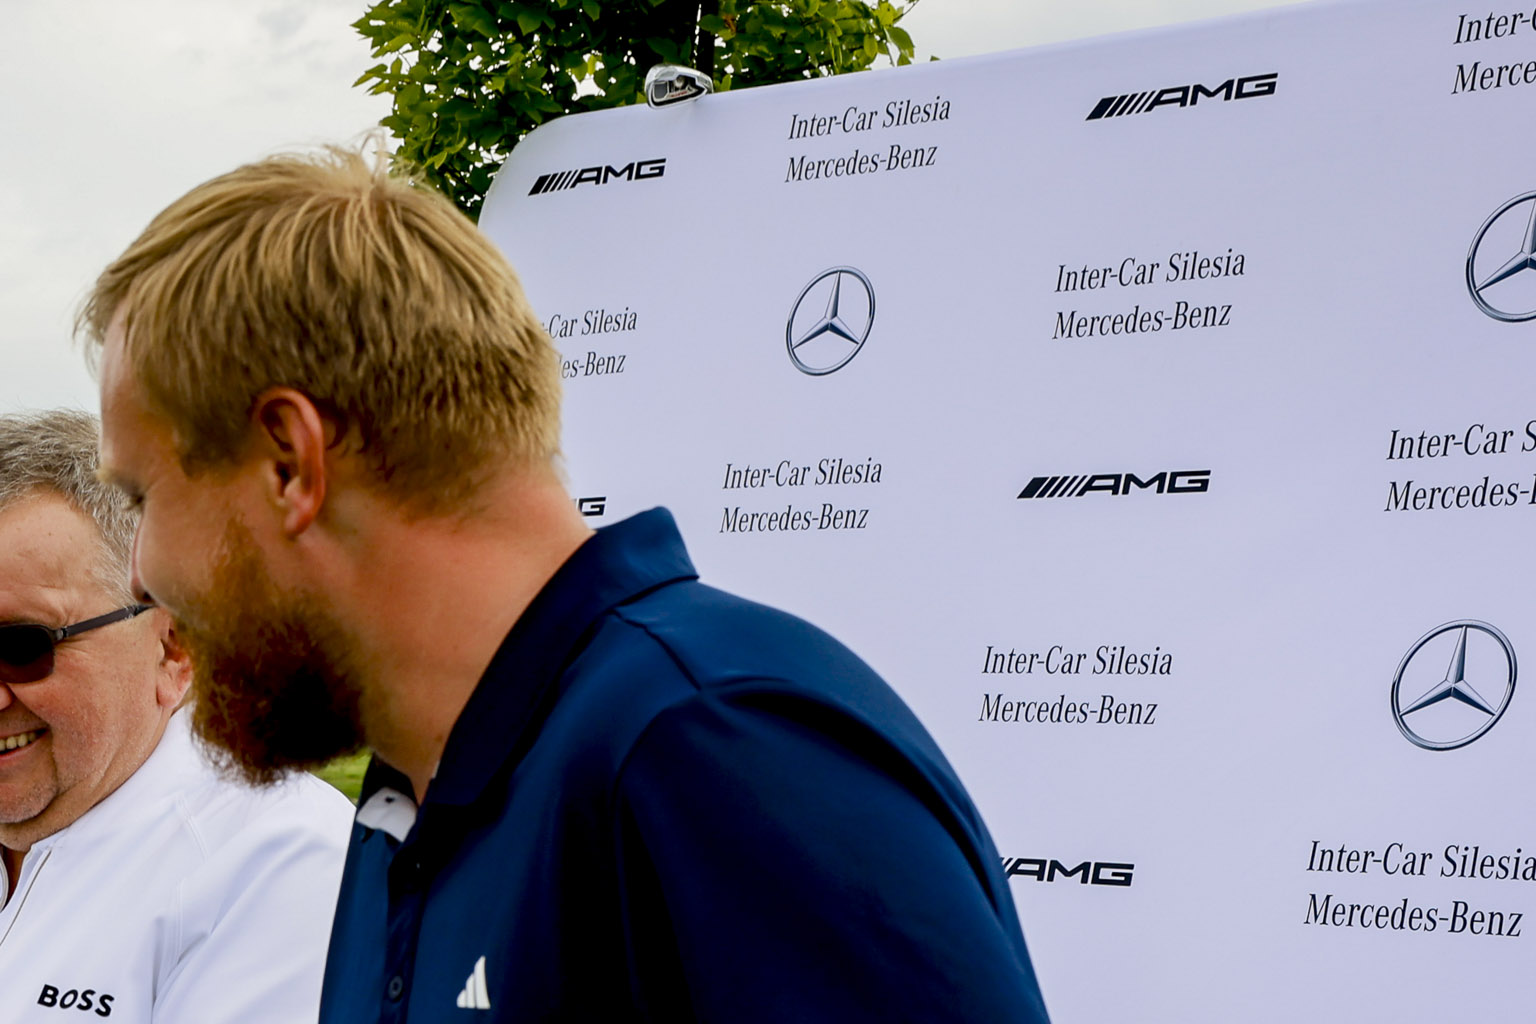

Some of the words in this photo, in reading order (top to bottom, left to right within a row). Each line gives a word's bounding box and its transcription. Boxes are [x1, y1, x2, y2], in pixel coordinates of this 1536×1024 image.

[1145, 72, 1278, 113] AMG
[788, 105, 878, 140] Inter-Car
[882, 96, 951, 128] Silesia
[569, 158, 667, 190] AMG
[784, 143, 938, 183] Mercedes-Benz
[1055, 257, 1159, 293] Inter-Car
[1166, 248, 1245, 284] Silesia
[581, 306, 638, 336] Silesia
[1052, 301, 1232, 340] Mercedes-Benz
[559, 351, 626, 379] es-Benz
[1386, 423, 1514, 460] Inter-Car
[722, 460, 810, 490] Inter-Car
[814, 457, 882, 486] Silesia
[1076, 469, 1211, 497] AMG
[1384, 474, 1536, 511] Mercedes-
[720, 503, 869, 534] Mercedes-Benz
[981, 645, 1087, 676] Inter-Car
[1092, 646, 1173, 676] Silesia
[978, 693, 1158, 725] Mercedes-Benz
[1005, 857, 1135, 887] AMG
[1306, 840, 1433, 877] Inter-Car
[1440, 844, 1536, 882] Silesia
[1303, 893, 1524, 938] Mercedes-Benz
[37, 983, 115, 1018] BOSS
